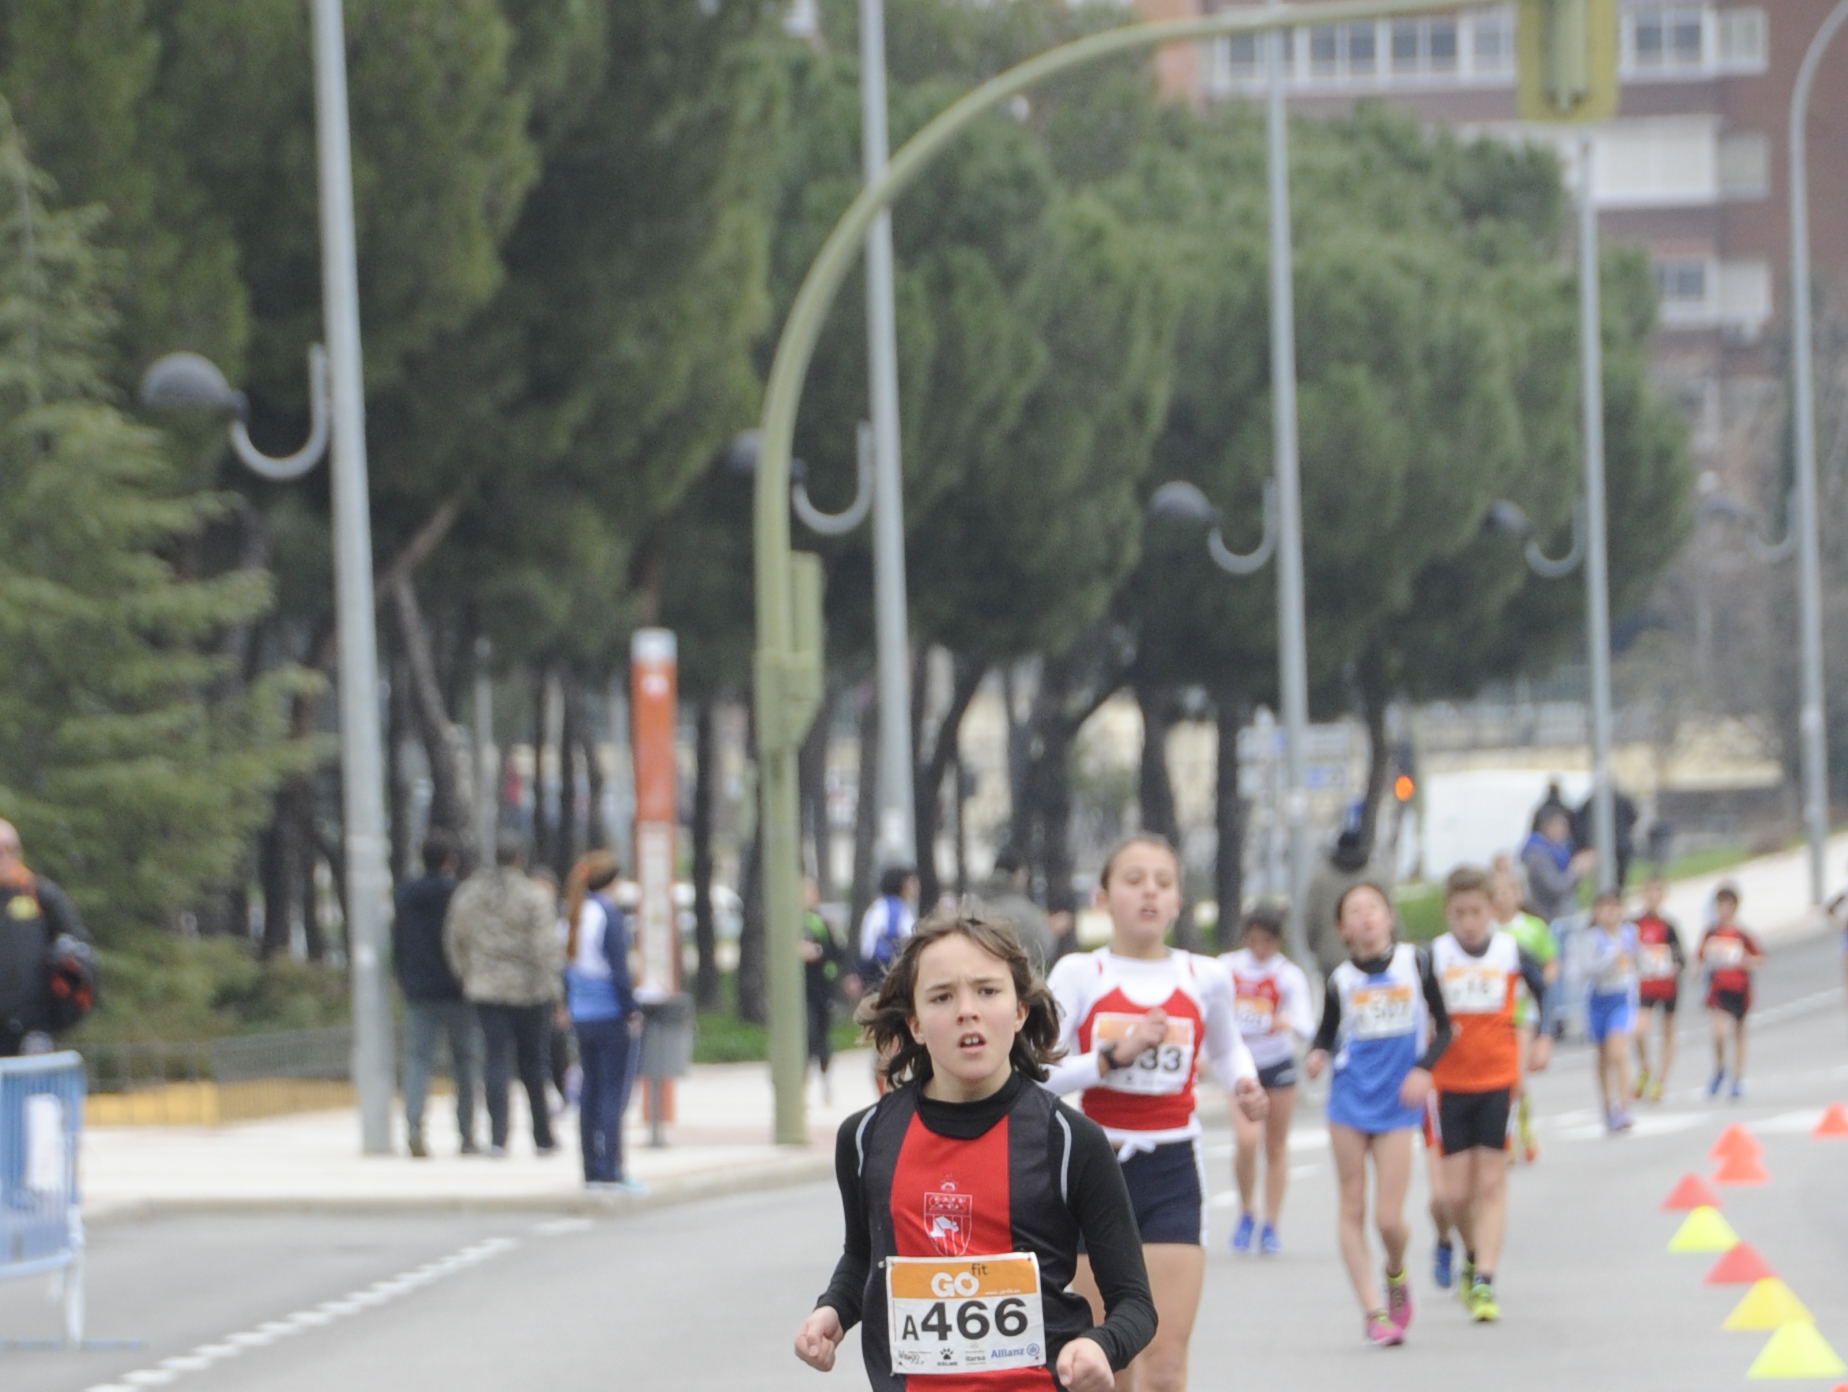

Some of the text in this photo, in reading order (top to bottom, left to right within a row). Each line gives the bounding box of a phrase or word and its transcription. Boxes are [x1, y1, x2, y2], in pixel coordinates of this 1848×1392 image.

[1139, 1046, 1182, 1071] 33
[931, 1263, 988, 1297] GO fit
[990, 1347, 1025, 1359] Allianz
